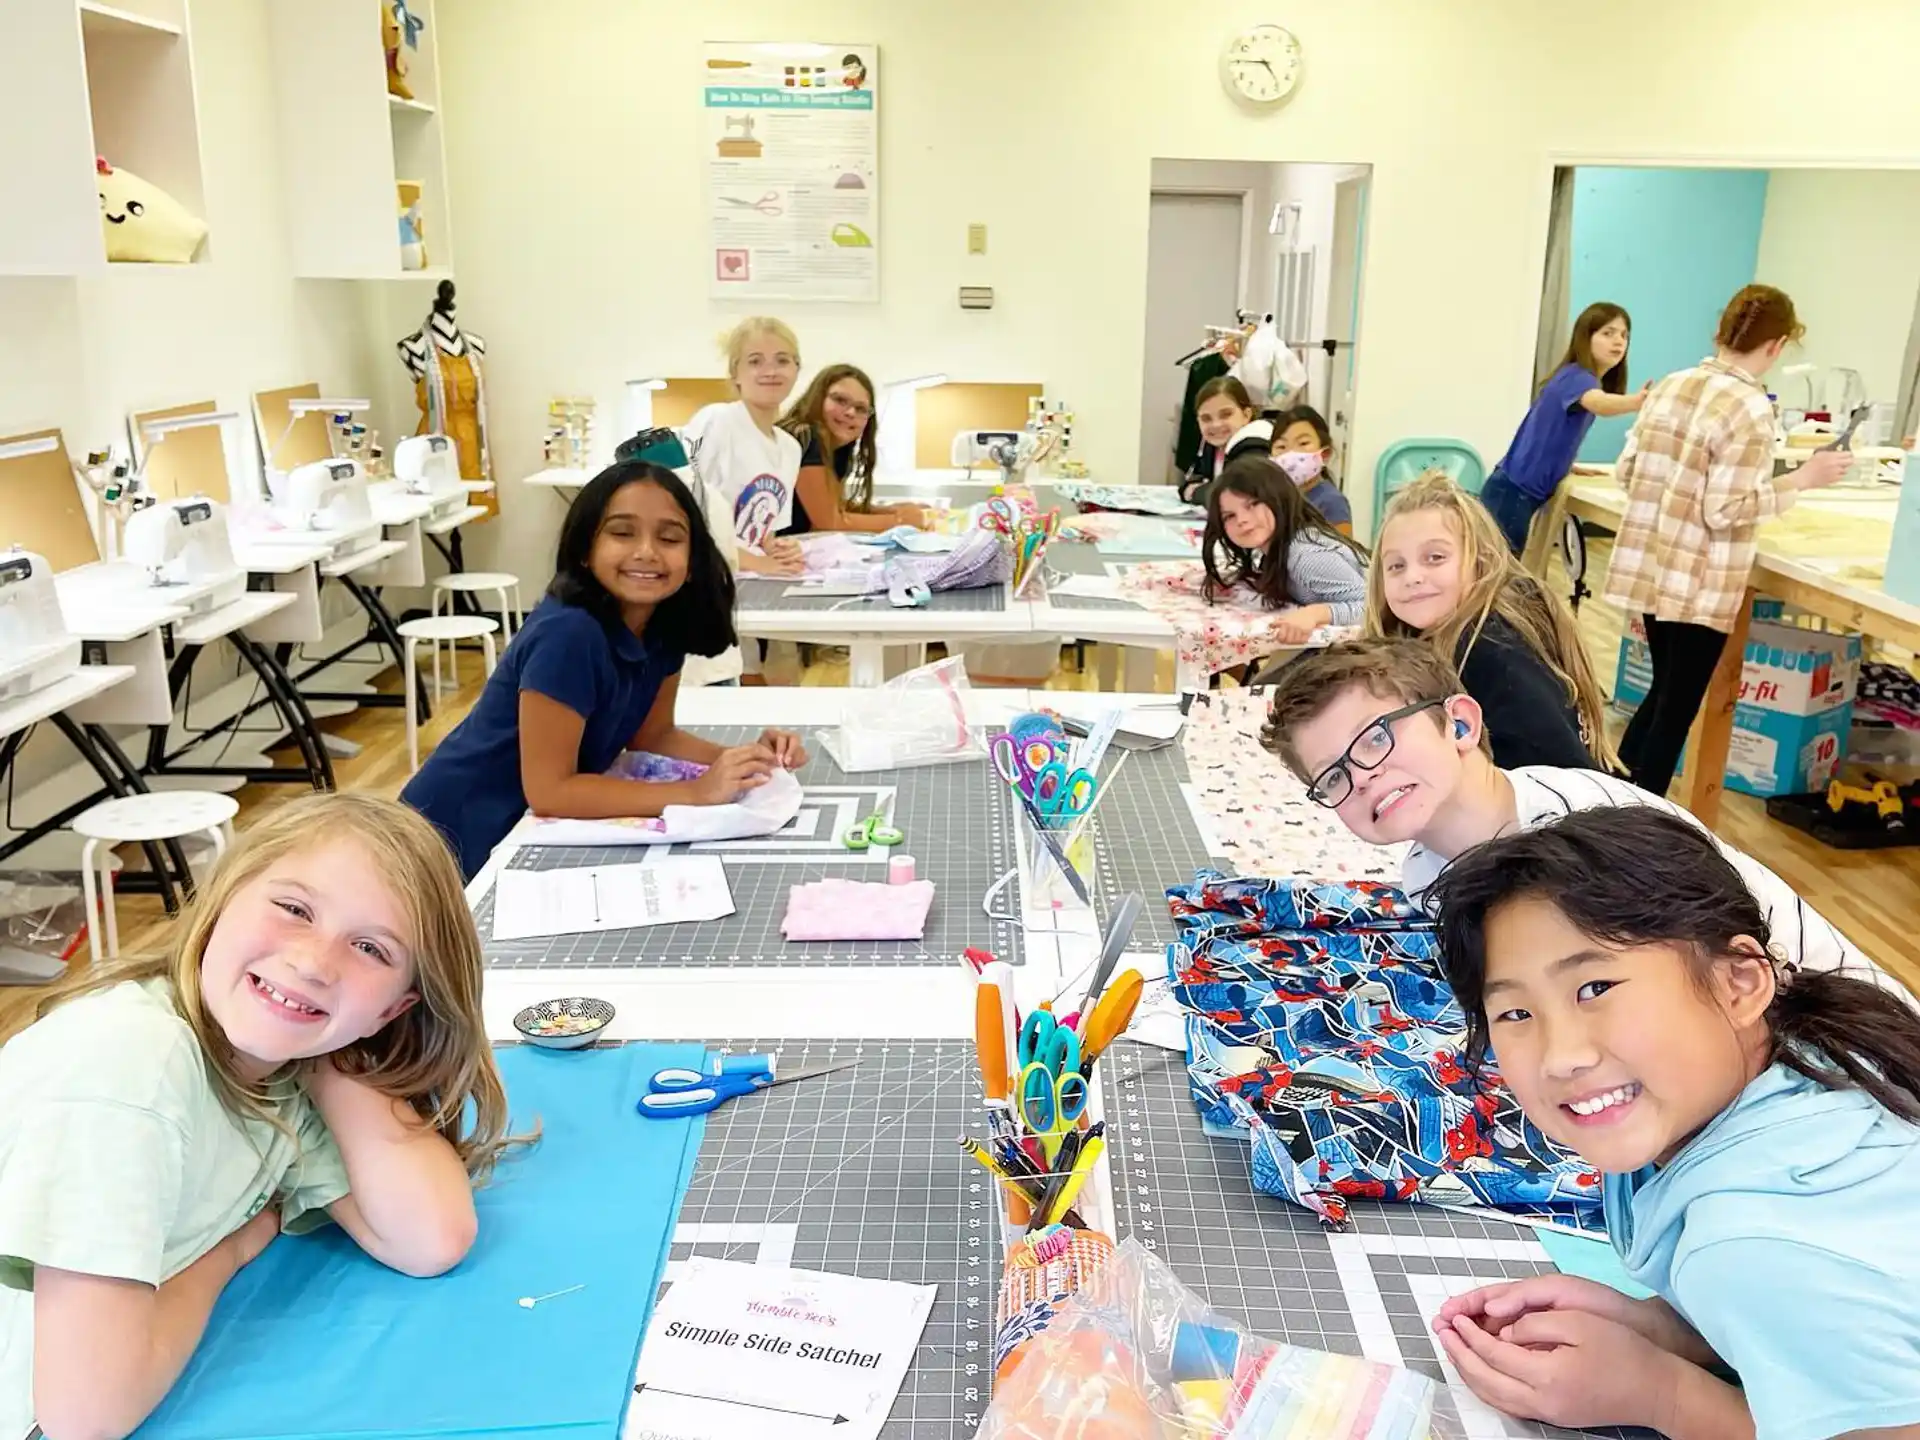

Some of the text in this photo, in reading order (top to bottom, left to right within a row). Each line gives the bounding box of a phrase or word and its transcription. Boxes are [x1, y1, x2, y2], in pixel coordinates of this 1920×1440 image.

[1817, 736, 1834, 762] 10
[970, 1183, 981, 1193] 10
[970, 1200, 981, 1210] 11
[969, 1218, 981, 1228] 12
[968, 1236, 980, 1247] 13
[968, 1255, 980, 1267] 14
[968, 1275, 979, 1287] 15
[967, 1296, 979, 1308] 16
[967, 1318, 979, 1329] 17
[664, 1321, 882, 1369] Simple Side Satchel
[966, 1340, 978, 1352] 18
[965, 1363, 978, 1376] 19
[965, 1387, 978, 1401] 20
[964, 1412, 978, 1426] 21
